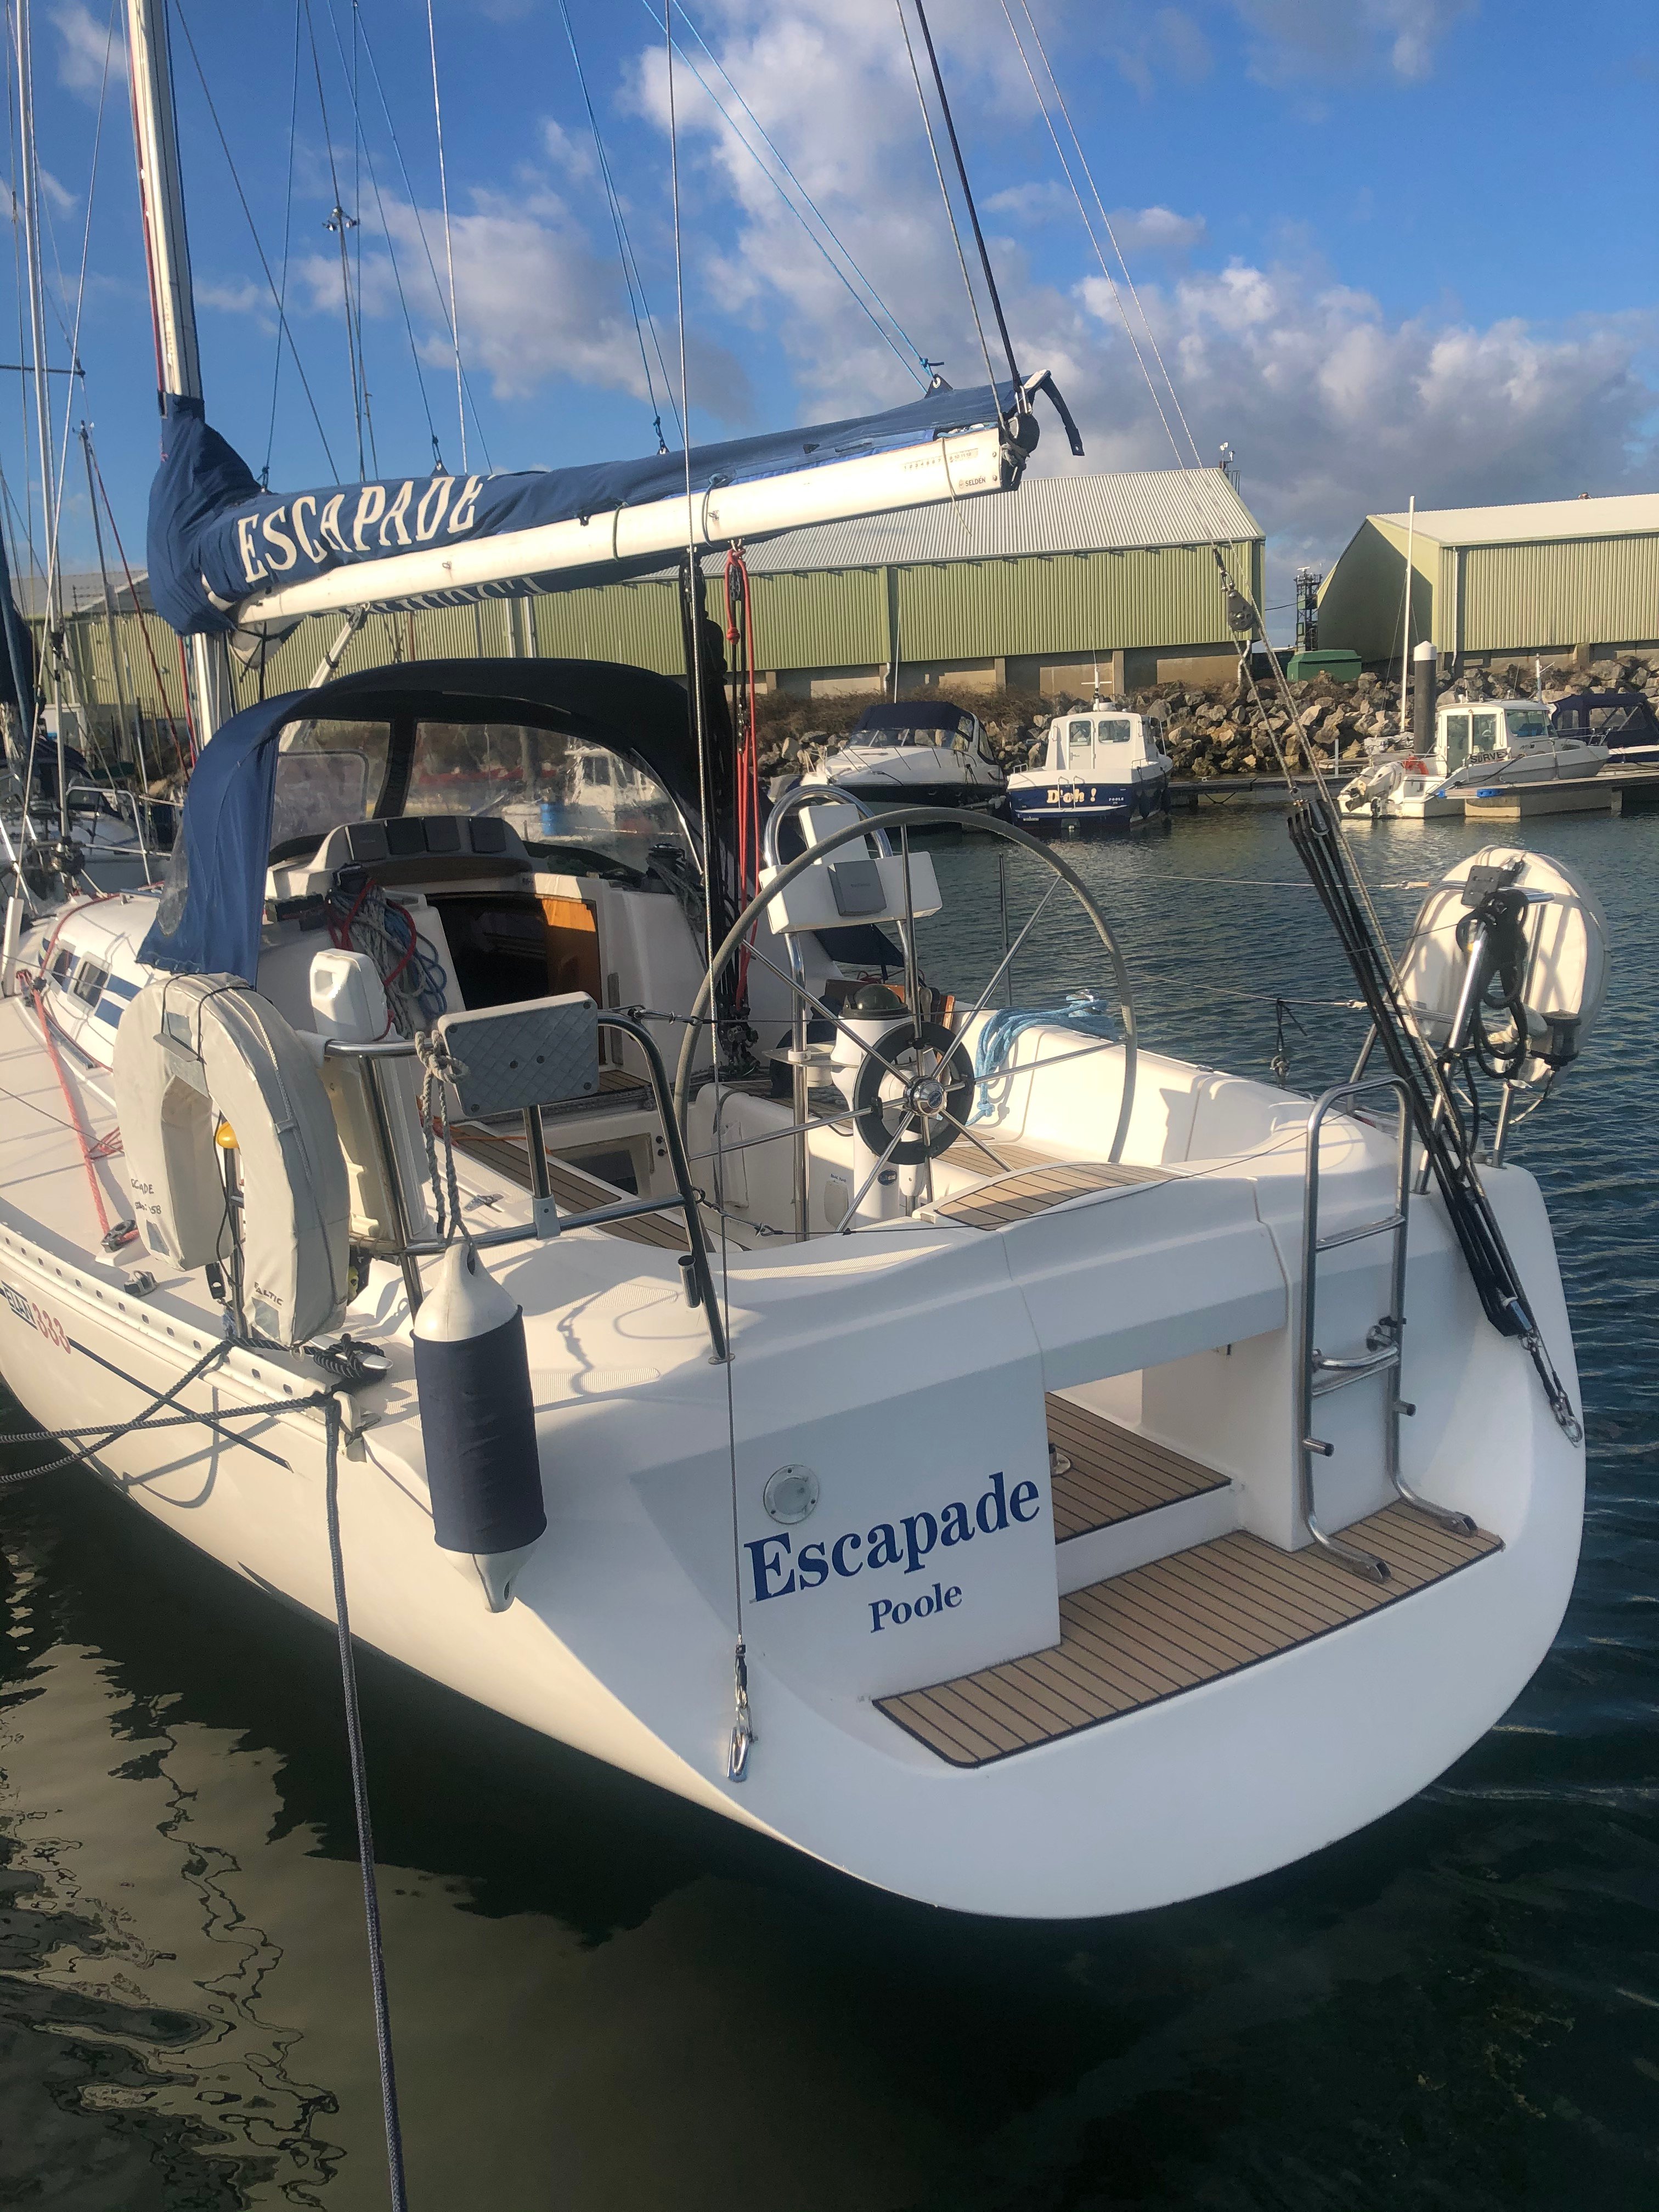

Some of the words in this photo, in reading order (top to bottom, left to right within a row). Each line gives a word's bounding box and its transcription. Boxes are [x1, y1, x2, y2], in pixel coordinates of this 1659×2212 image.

[238, 475, 495, 583] ESCAPADE
[1470, 751, 1508, 764] SURVE
[32, 1302, 71, 1355] 333
[744, 1471, 1040, 1603] Escapade
[868, 1582, 963, 1634] Poole
